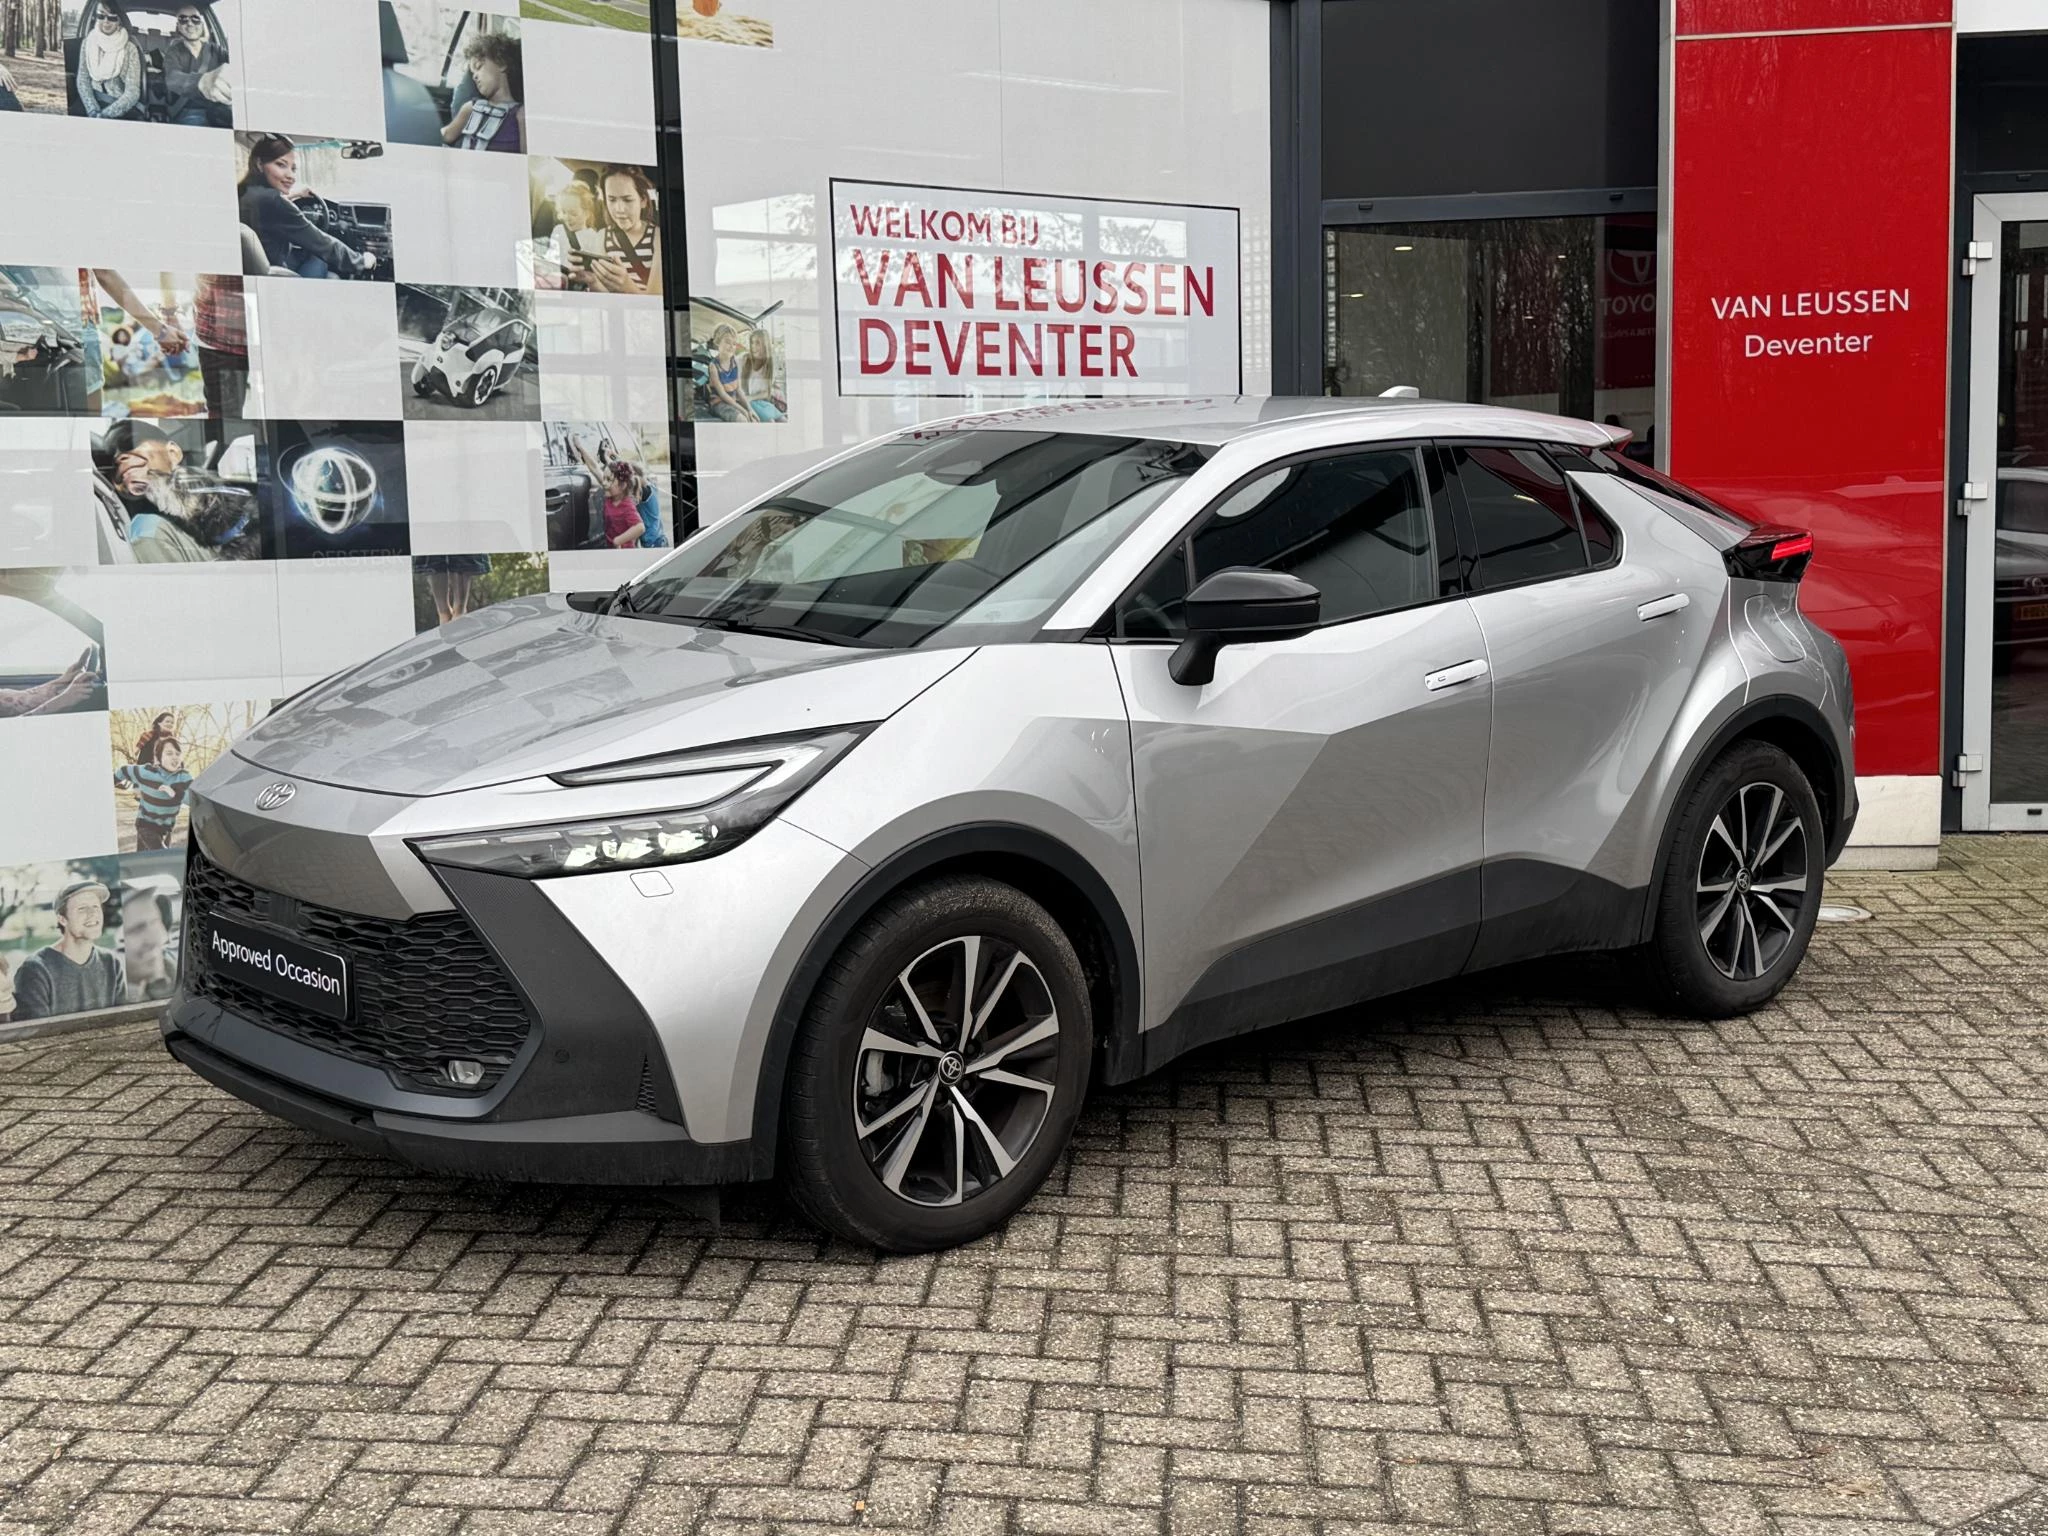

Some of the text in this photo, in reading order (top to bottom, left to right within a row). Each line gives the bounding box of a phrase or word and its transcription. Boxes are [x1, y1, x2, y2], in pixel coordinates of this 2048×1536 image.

[850, 203, 1039, 246] WELKOM BIJ
[854, 248, 1215, 318] VAN LEUSSEN
[1711, 288, 1909, 320] VAN LEUSSEN
[858, 317, 1138, 379] DEVENTER
[1745, 332, 1873, 358] Deventer
[212, 930, 340, 996] Approved Occasion
